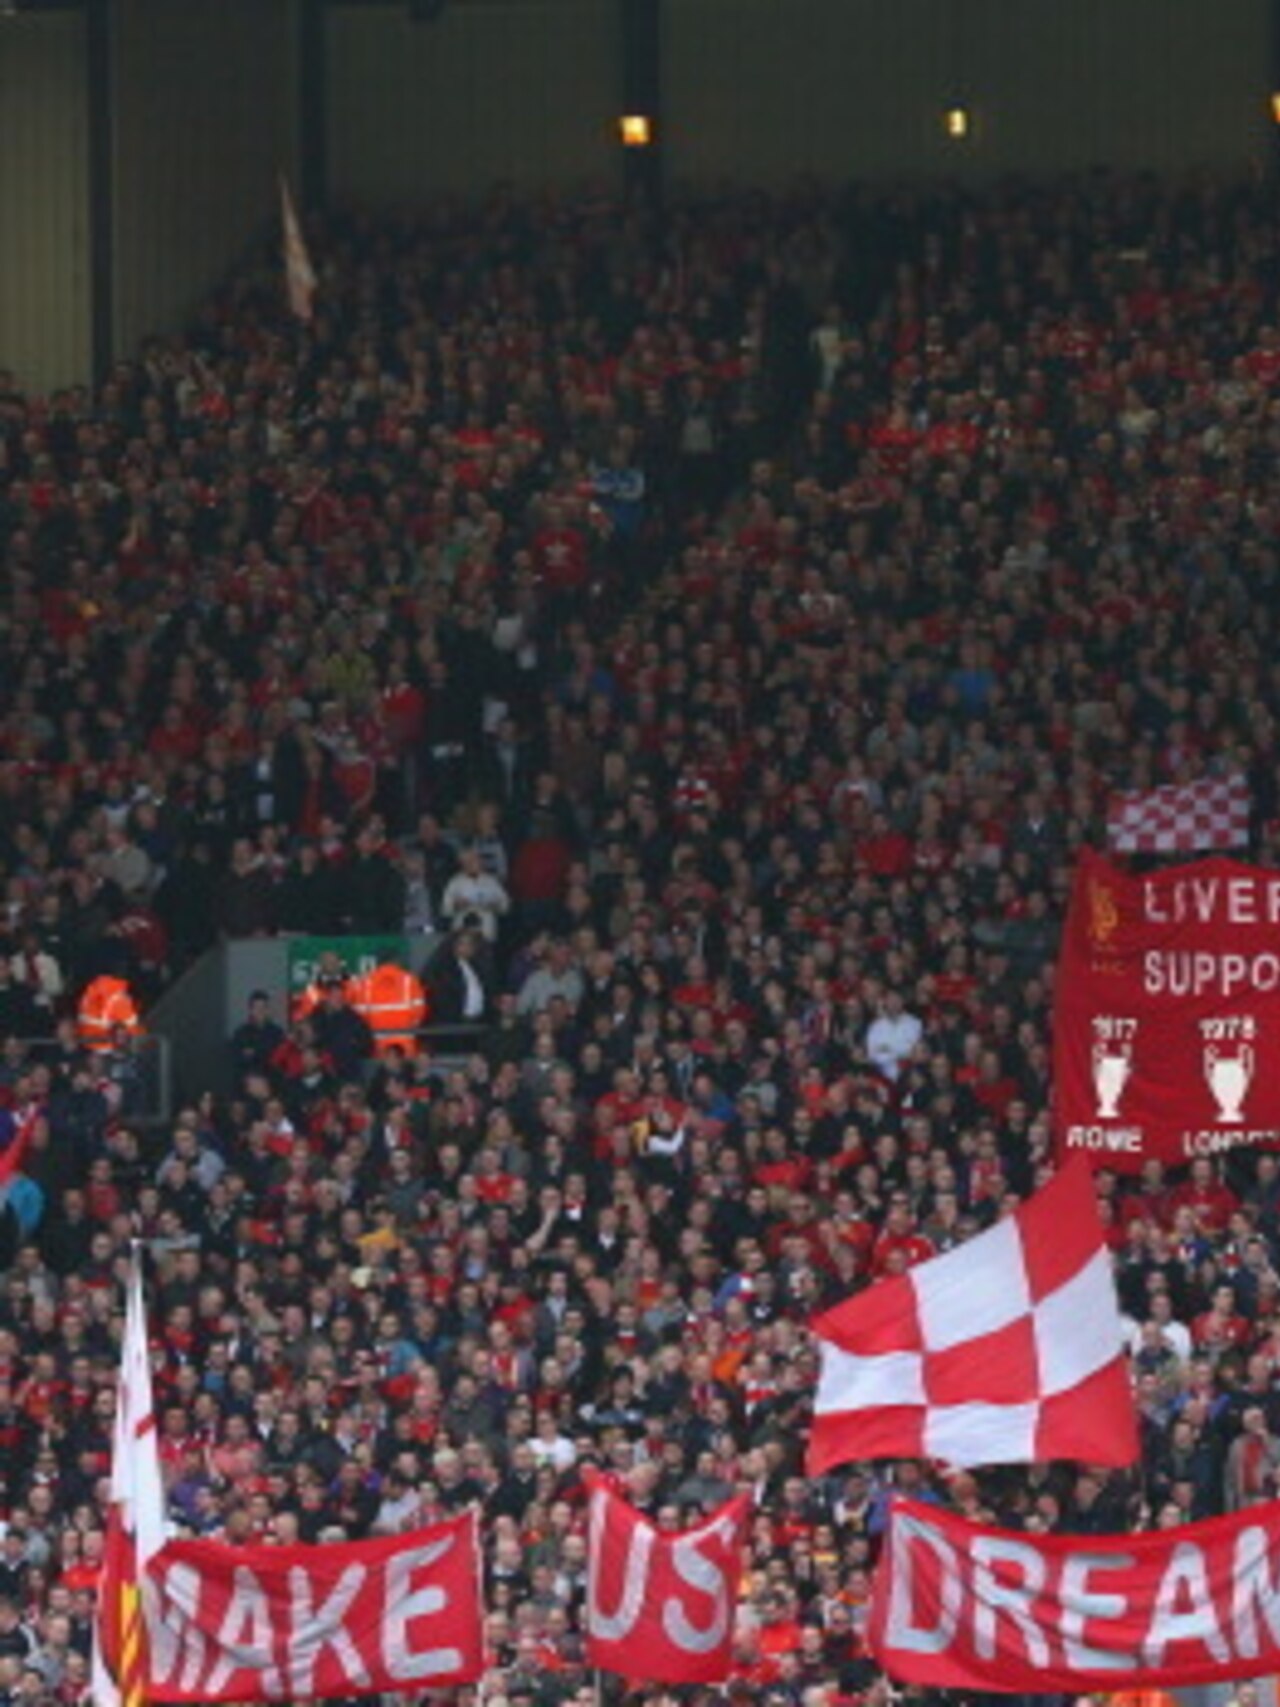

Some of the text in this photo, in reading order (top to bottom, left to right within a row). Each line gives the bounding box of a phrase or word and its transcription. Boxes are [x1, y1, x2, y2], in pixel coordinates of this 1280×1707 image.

[1067, 1126, 1143, 1152] ROME
[139, 1533, 465, 1695] MAKE
[590, 1488, 739, 1655] US
